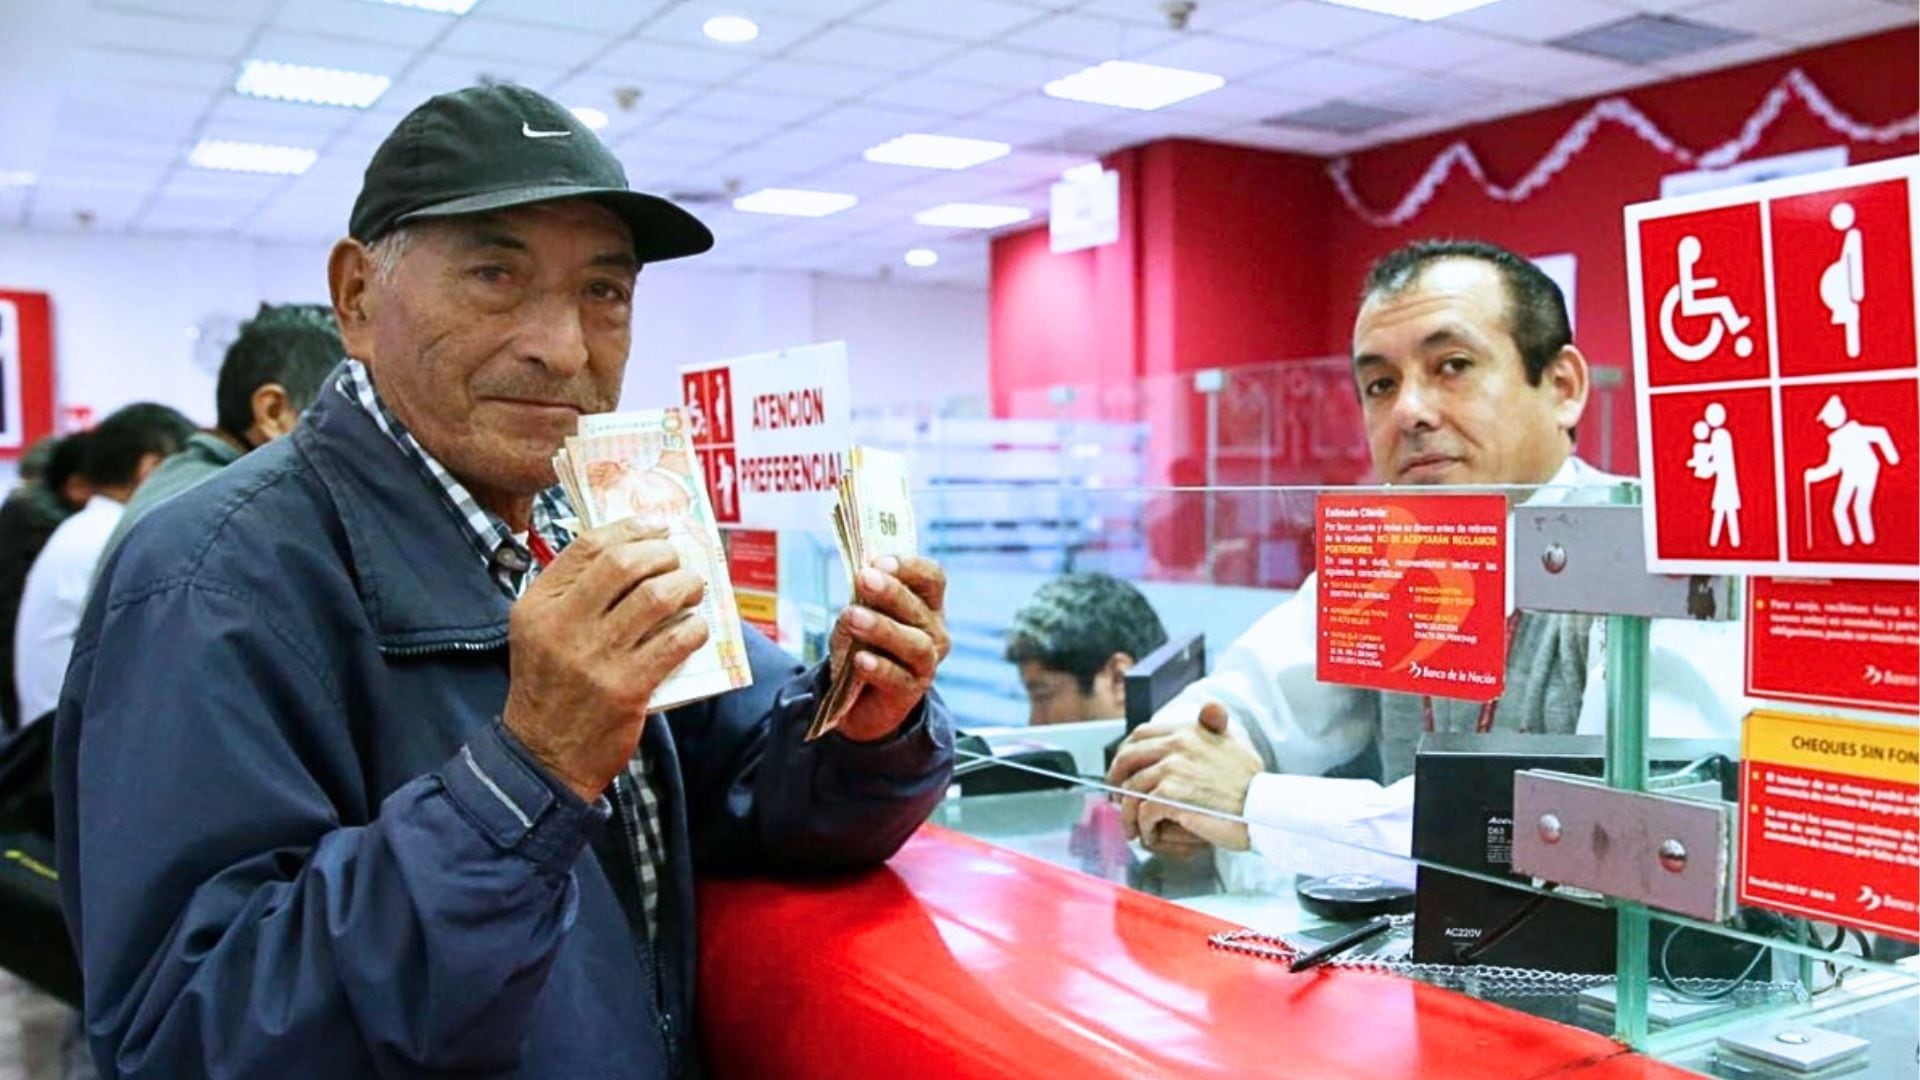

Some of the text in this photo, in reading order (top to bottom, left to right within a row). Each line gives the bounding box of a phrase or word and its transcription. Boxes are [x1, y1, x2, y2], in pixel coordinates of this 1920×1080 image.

[752, 389, 825, 429] ATENCION
[740, 452, 842, 493] PREFERENCIAL
[1325, 507, 1359, 517] Estimado
[879, 512, 897, 537] 50
[1377, 535, 1390, 544] NO
[1452, 535, 1497, 546] RECLAMOS
[1423, 666, 1497, 685] Banco de la Nación
[1791, 735, 1919, 765] CHEQUES SIN FON
[1444, 927, 1482, 938] AC220V
